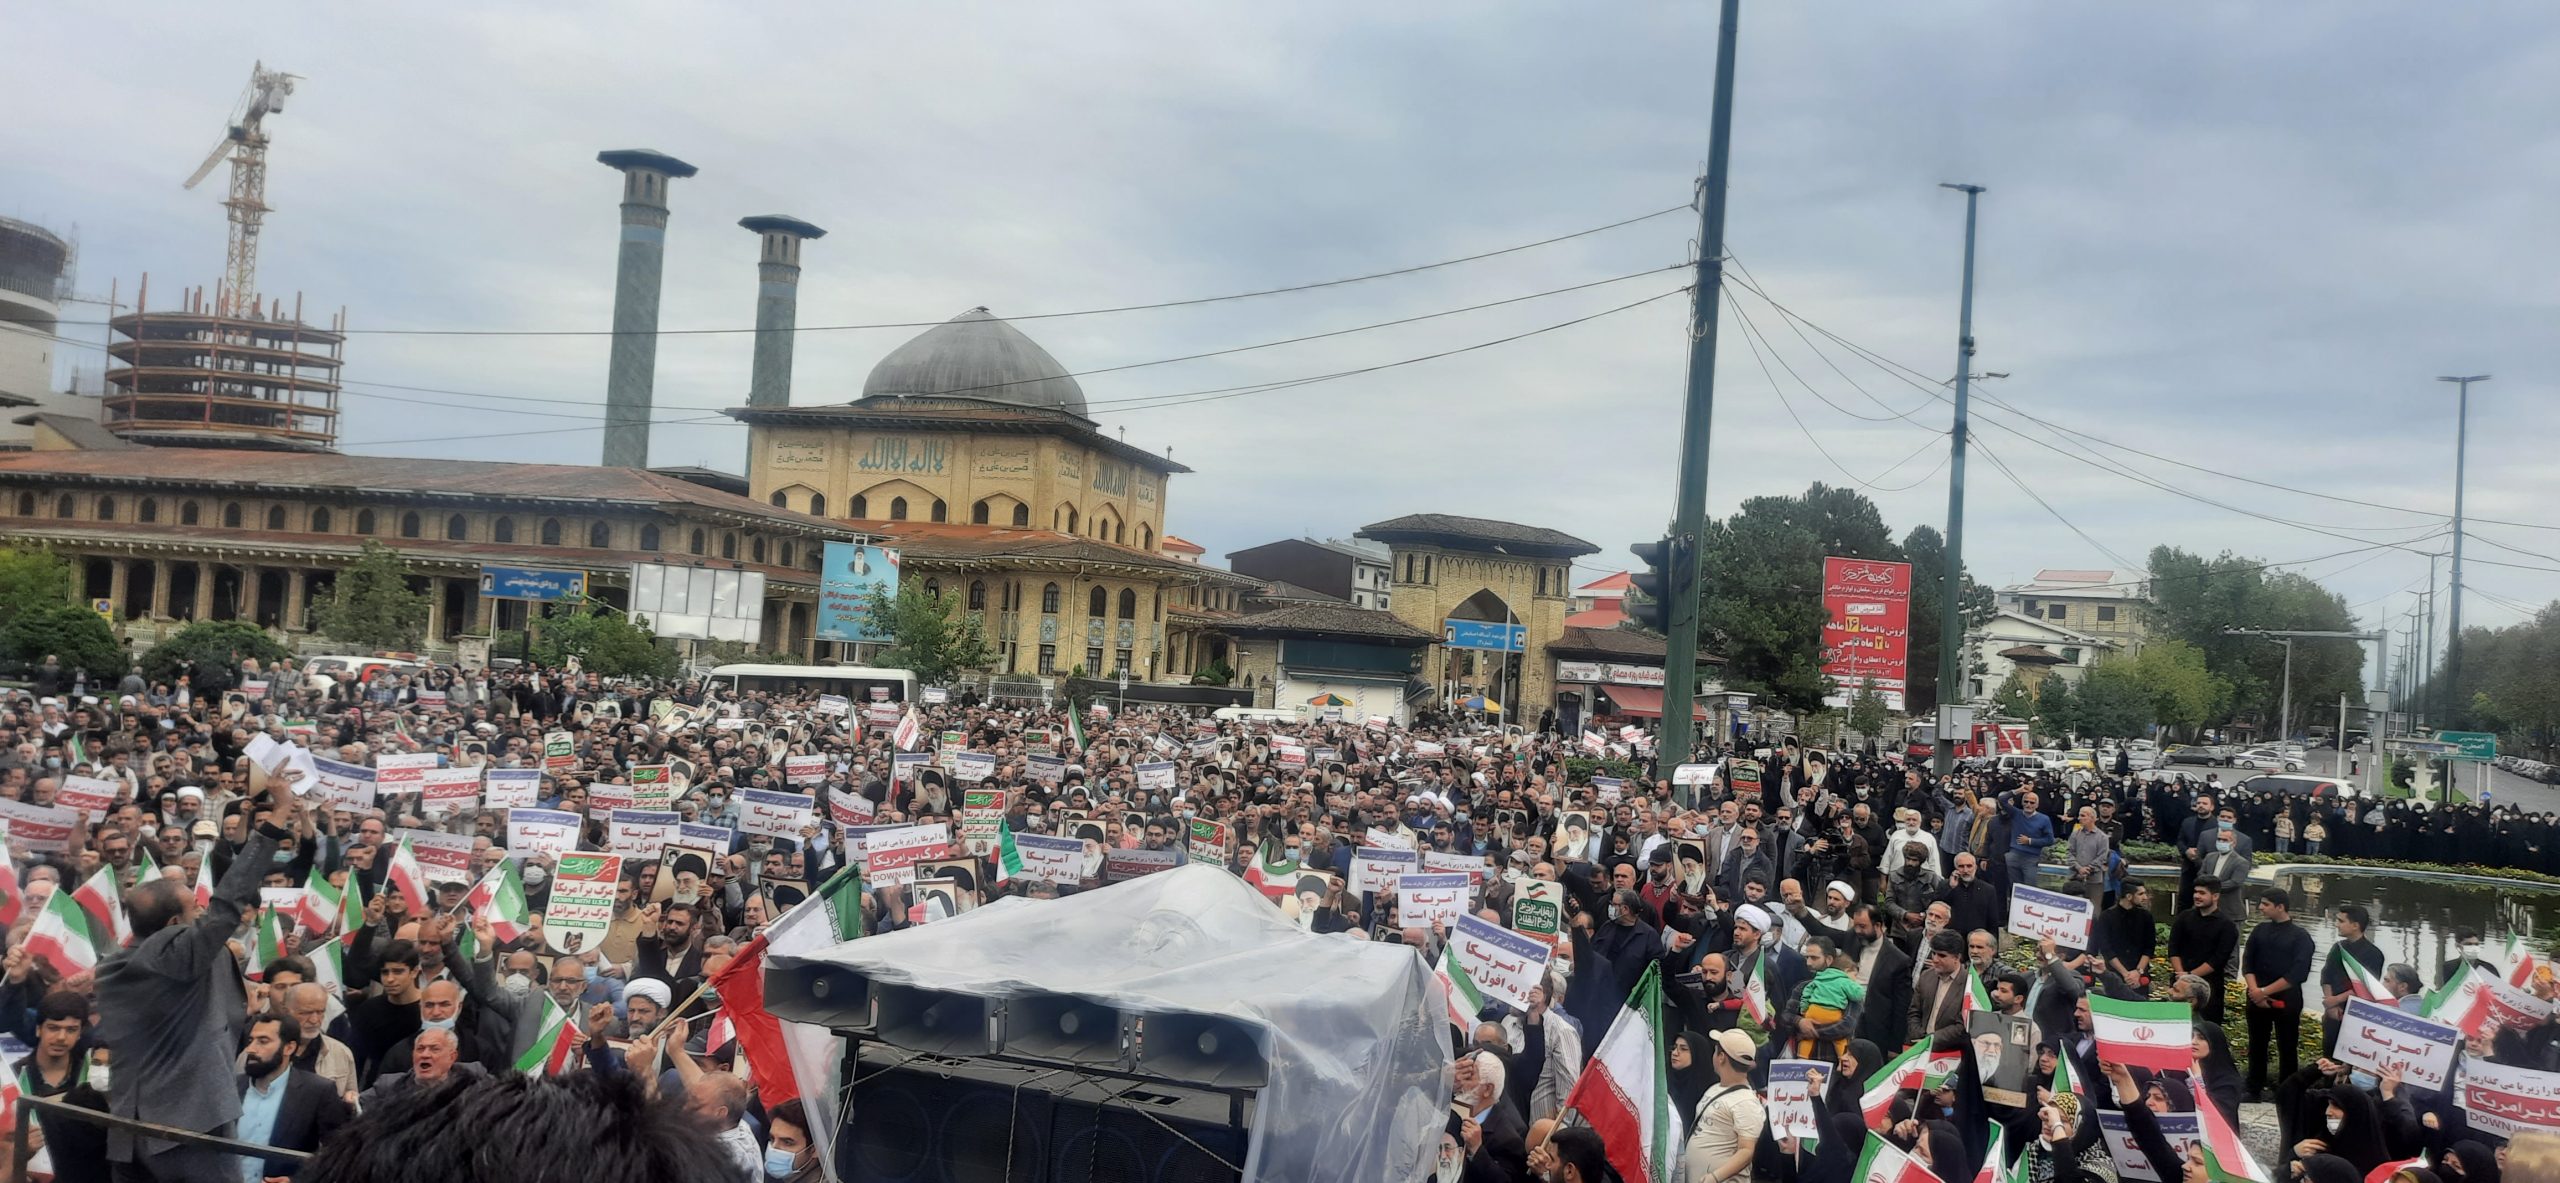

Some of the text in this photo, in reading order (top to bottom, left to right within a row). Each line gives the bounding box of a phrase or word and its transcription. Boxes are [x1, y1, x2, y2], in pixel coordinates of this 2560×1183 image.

[858, 436, 889, 471] الله
[1825, 618, 1905, 637] فروش با اقساط ۱۶ ماهه
[1861, 638, 1874, 647] ماه
[1887, 658, 1904, 667] فروش
[497, 782, 531, 793] آمریکا
[360, 801, 371, 809] رو
[753, 805, 800, 820] آمریکا
[850, 814, 870, 824] مرگ
[519, 826, 567, 839] آمریکا
[621, 827, 667, 840] آمریکا
[746, 820, 796, 834] به افول است
[920, 832, 938, 844] آمریکا
[514, 842, 531, 850] است
[615, 842, 655, 853] افول است
[869, 839, 888, 851] گذاریم
[889, 841, 899, 849] می
[1190, 841, 1223, 860] مرگ بر آمریکا
[441, 852, 466, 866] مرگ
[920, 847, 945, 860] مرگ
[1026, 850, 1071, 864] آمریکا
[1038, 866, 1079, 881] رو به افول
[1367, 863, 1405, 876] آمریکا
[873, 872, 900, 882] DOWN
[1363, 877, 1396, 888] افول است
[554, 882, 613, 898] مرگ بر آمریکا
[1412, 891, 1458, 907] آمریکا
[548, 905, 609, 919] مرگ بر اسرائیل
[1407, 908, 1457, 921] به افول است
[2024, 904, 2072, 923] آمریکا
[2016, 920, 2035, 931] است
[2060, 930, 2069, 941] به
[2070, 935, 2082, 944] رو
[1465, 940, 1527, 975] آمریکا
[1478, 969, 1518, 998] به افول
[2361, 1025, 2434, 1057] آمریکا
[2348, 1045, 2377, 1061] است
[2412, 1066, 2424, 1079] به
[2425, 1072, 2442, 1084] رو
[2469, 1075, 2499, 1086] گذاریم
[2516, 1082, 2524, 1093] پا
[2525, 1087, 2540, 1095] زیر
[2542, 1086, 2551, 1097] را
[2471, 1090, 2546, 1121] بر امریکا
[1782, 1109, 1808, 1129] به افول
[2469, 1111, 2511, 1132] DOWN
[2125, 1159, 2151, 1171] است
